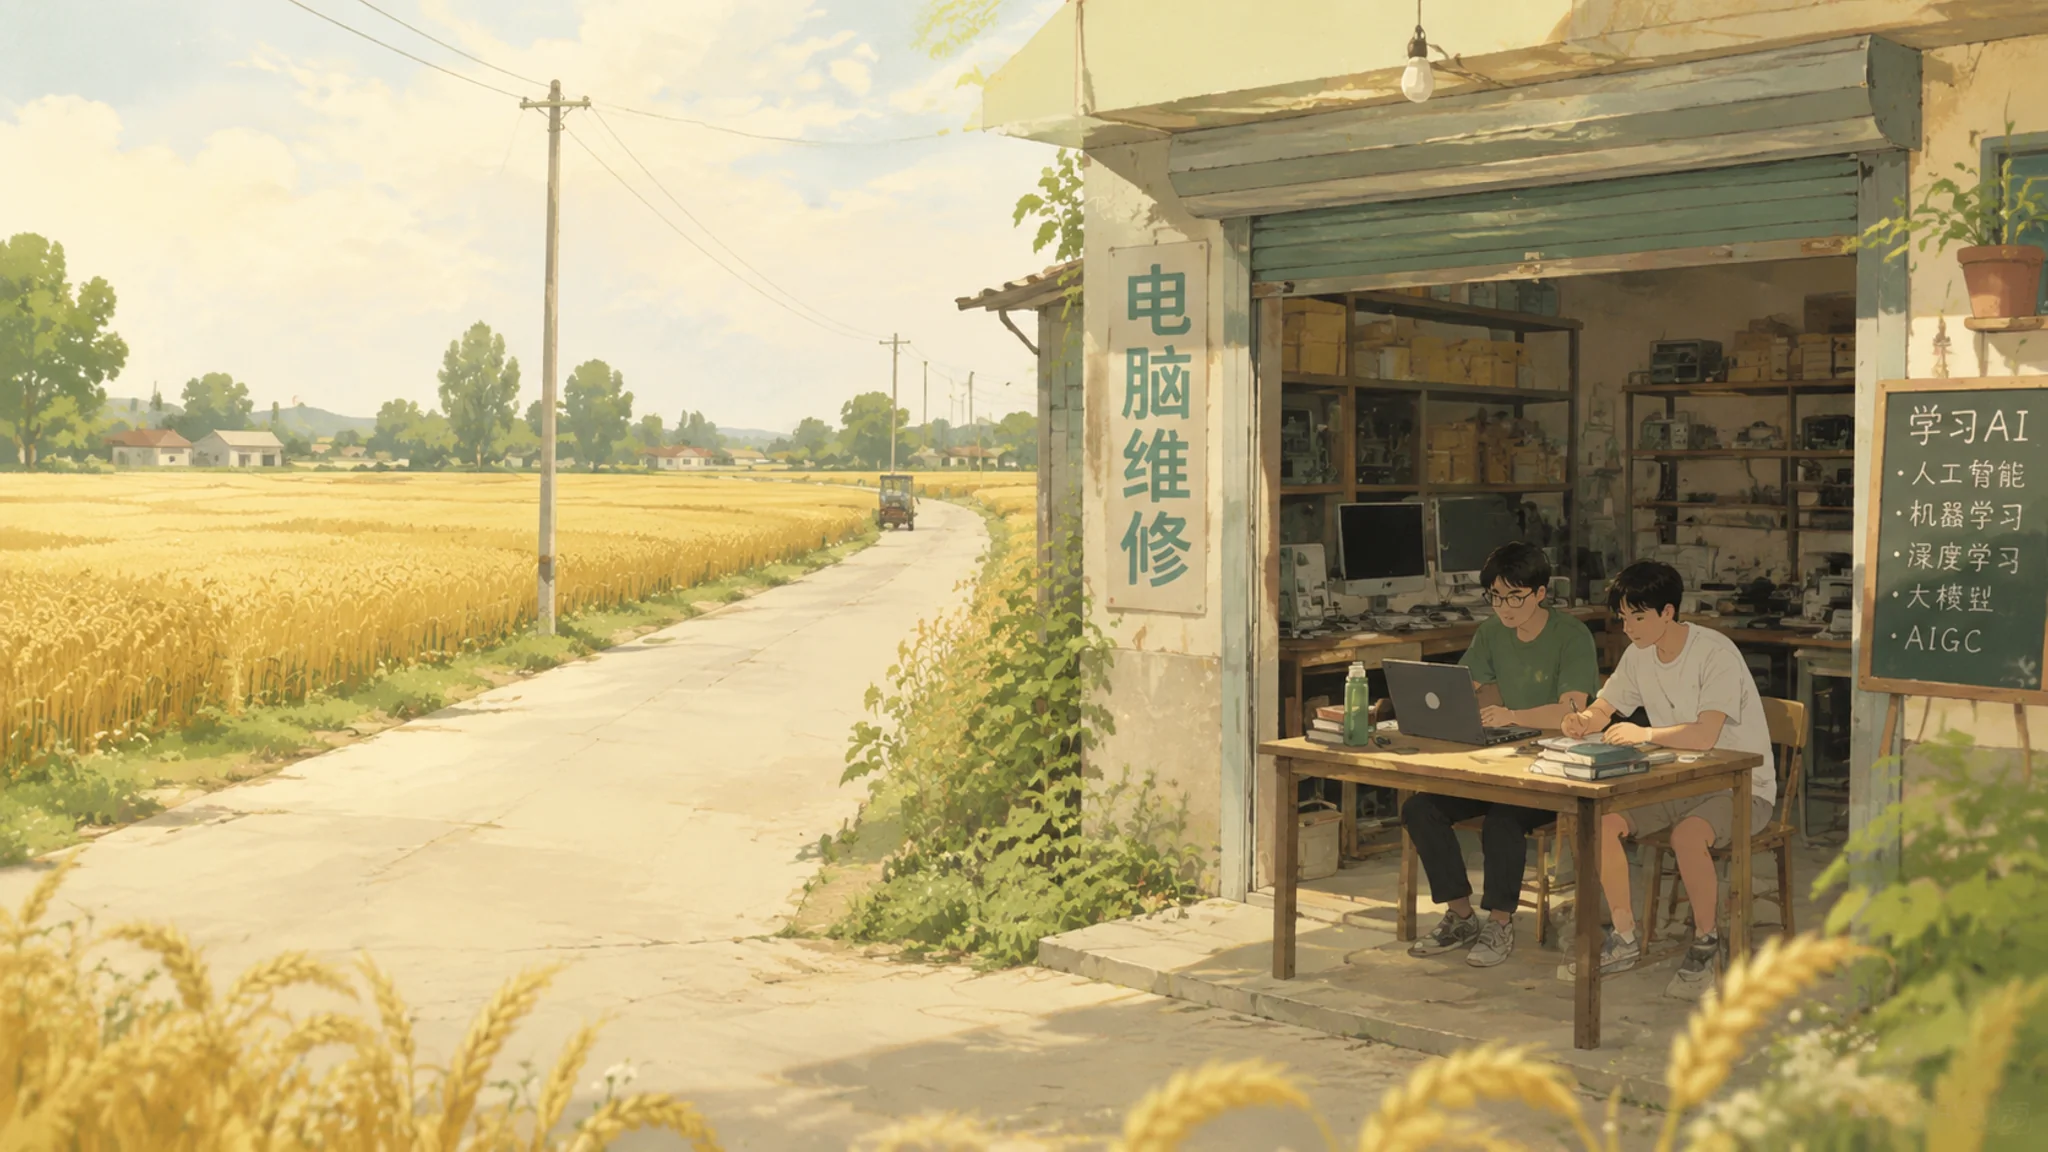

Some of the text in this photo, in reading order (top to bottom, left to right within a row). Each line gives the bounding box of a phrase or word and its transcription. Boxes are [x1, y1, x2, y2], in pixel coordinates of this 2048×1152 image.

[1121, 263, 1192, 588] 电脑维修
[1909, 404, 2029, 446] 学习AI
[1909, 499, 2022, 531] 机器学习
[1904, 625, 1982, 653] AIGC
